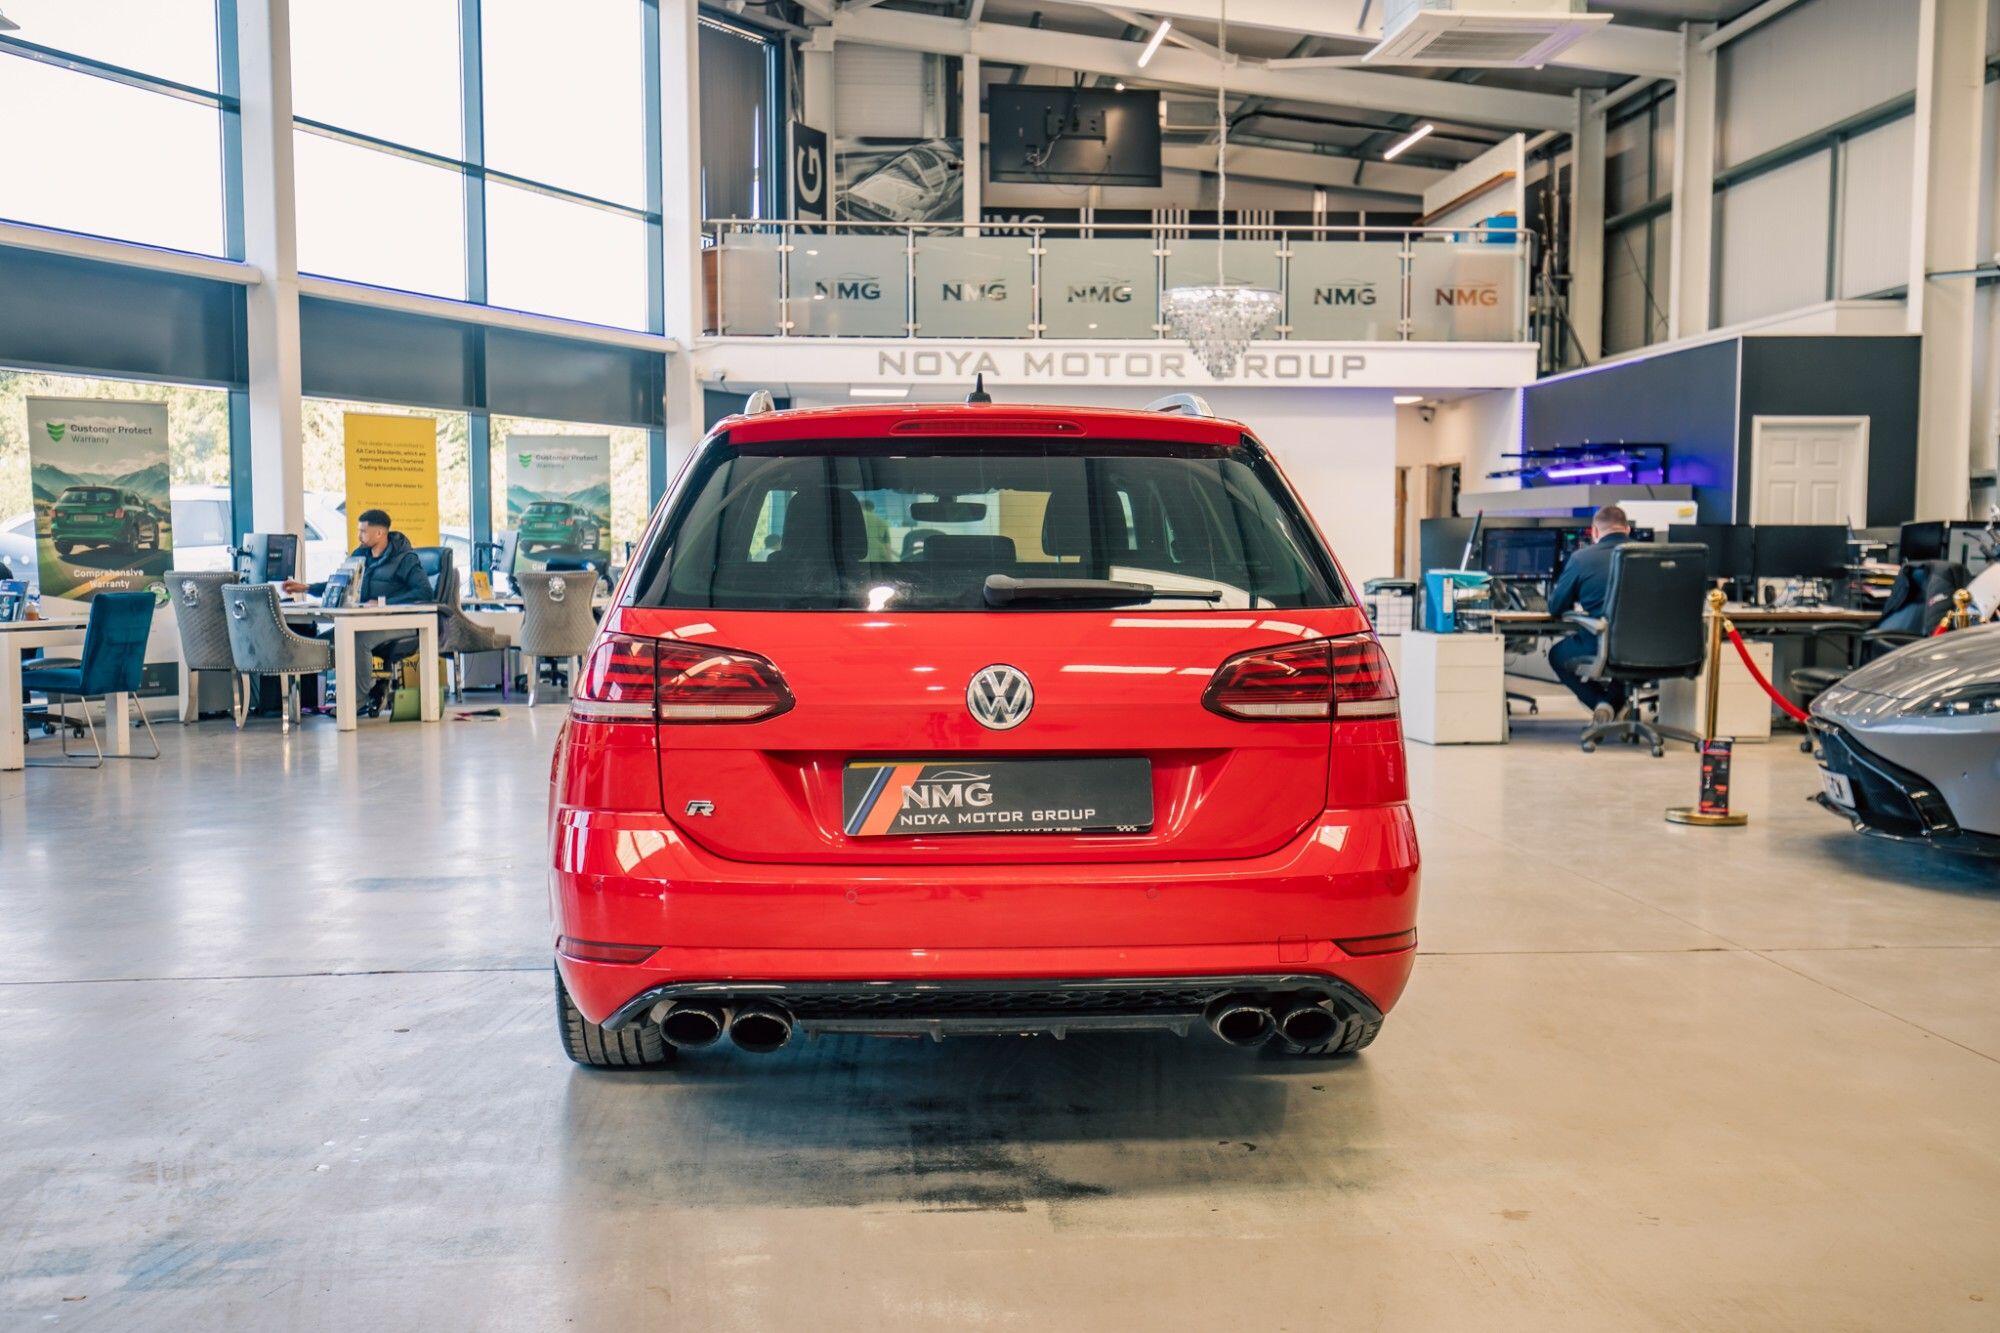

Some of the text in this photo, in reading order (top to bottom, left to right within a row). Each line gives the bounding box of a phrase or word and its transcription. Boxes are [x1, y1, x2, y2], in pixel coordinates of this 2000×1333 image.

[942, 283, 1007, 301] NMG
[1313, 288, 1376, 305] NMG
[1435, 288, 1498, 306] NMG
[878, 351, 1366, 379] NOYA MOTOR ROUP
[70, 424, 152, 435] Customer Protect
[71, 435, 109, 444] Warranty
[73, 568, 144, 578] Comprehensive
[90, 579, 130, 589] Warranty
[901, 782, 993, 810] NMG
[685, 800, 715, 816] R
[900, 808, 1096, 826] NOYA MOTOR GROUP
